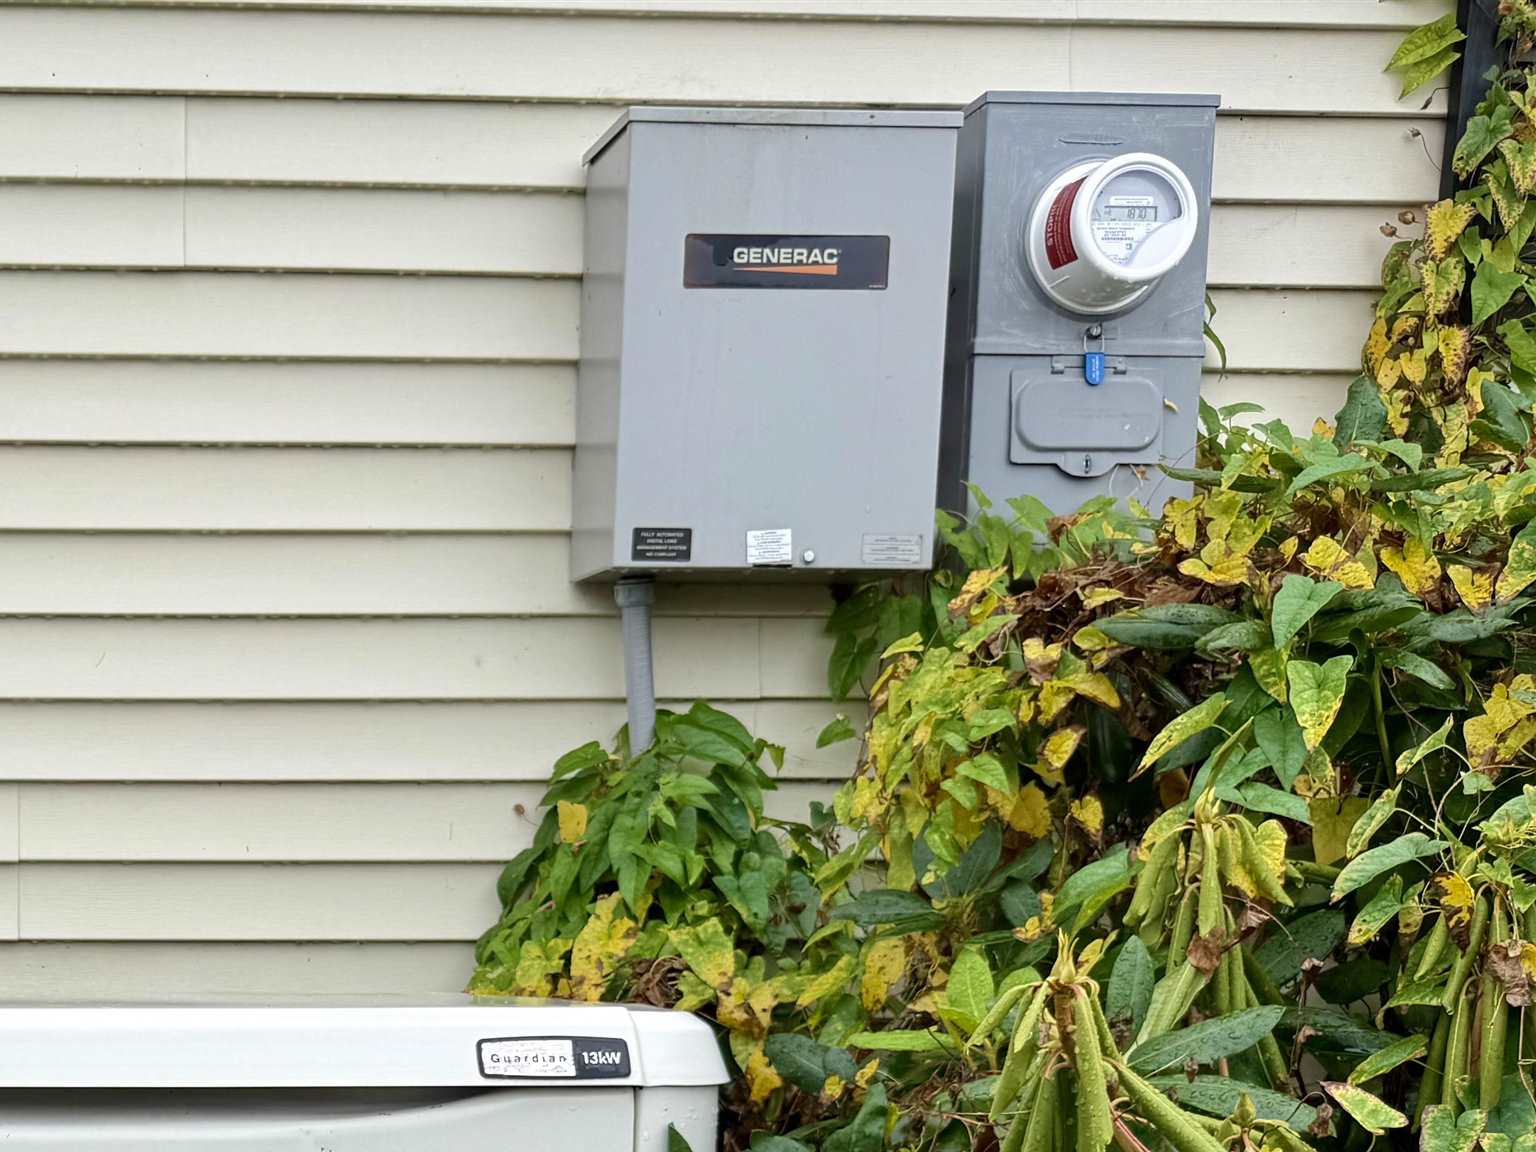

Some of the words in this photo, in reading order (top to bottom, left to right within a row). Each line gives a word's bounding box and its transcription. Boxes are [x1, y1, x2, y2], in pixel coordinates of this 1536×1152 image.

[732, 247, 839, 264] GENERAC
[490, 1053, 567, 1064] Guardian
[582, 1051, 622, 1065] 13kW
